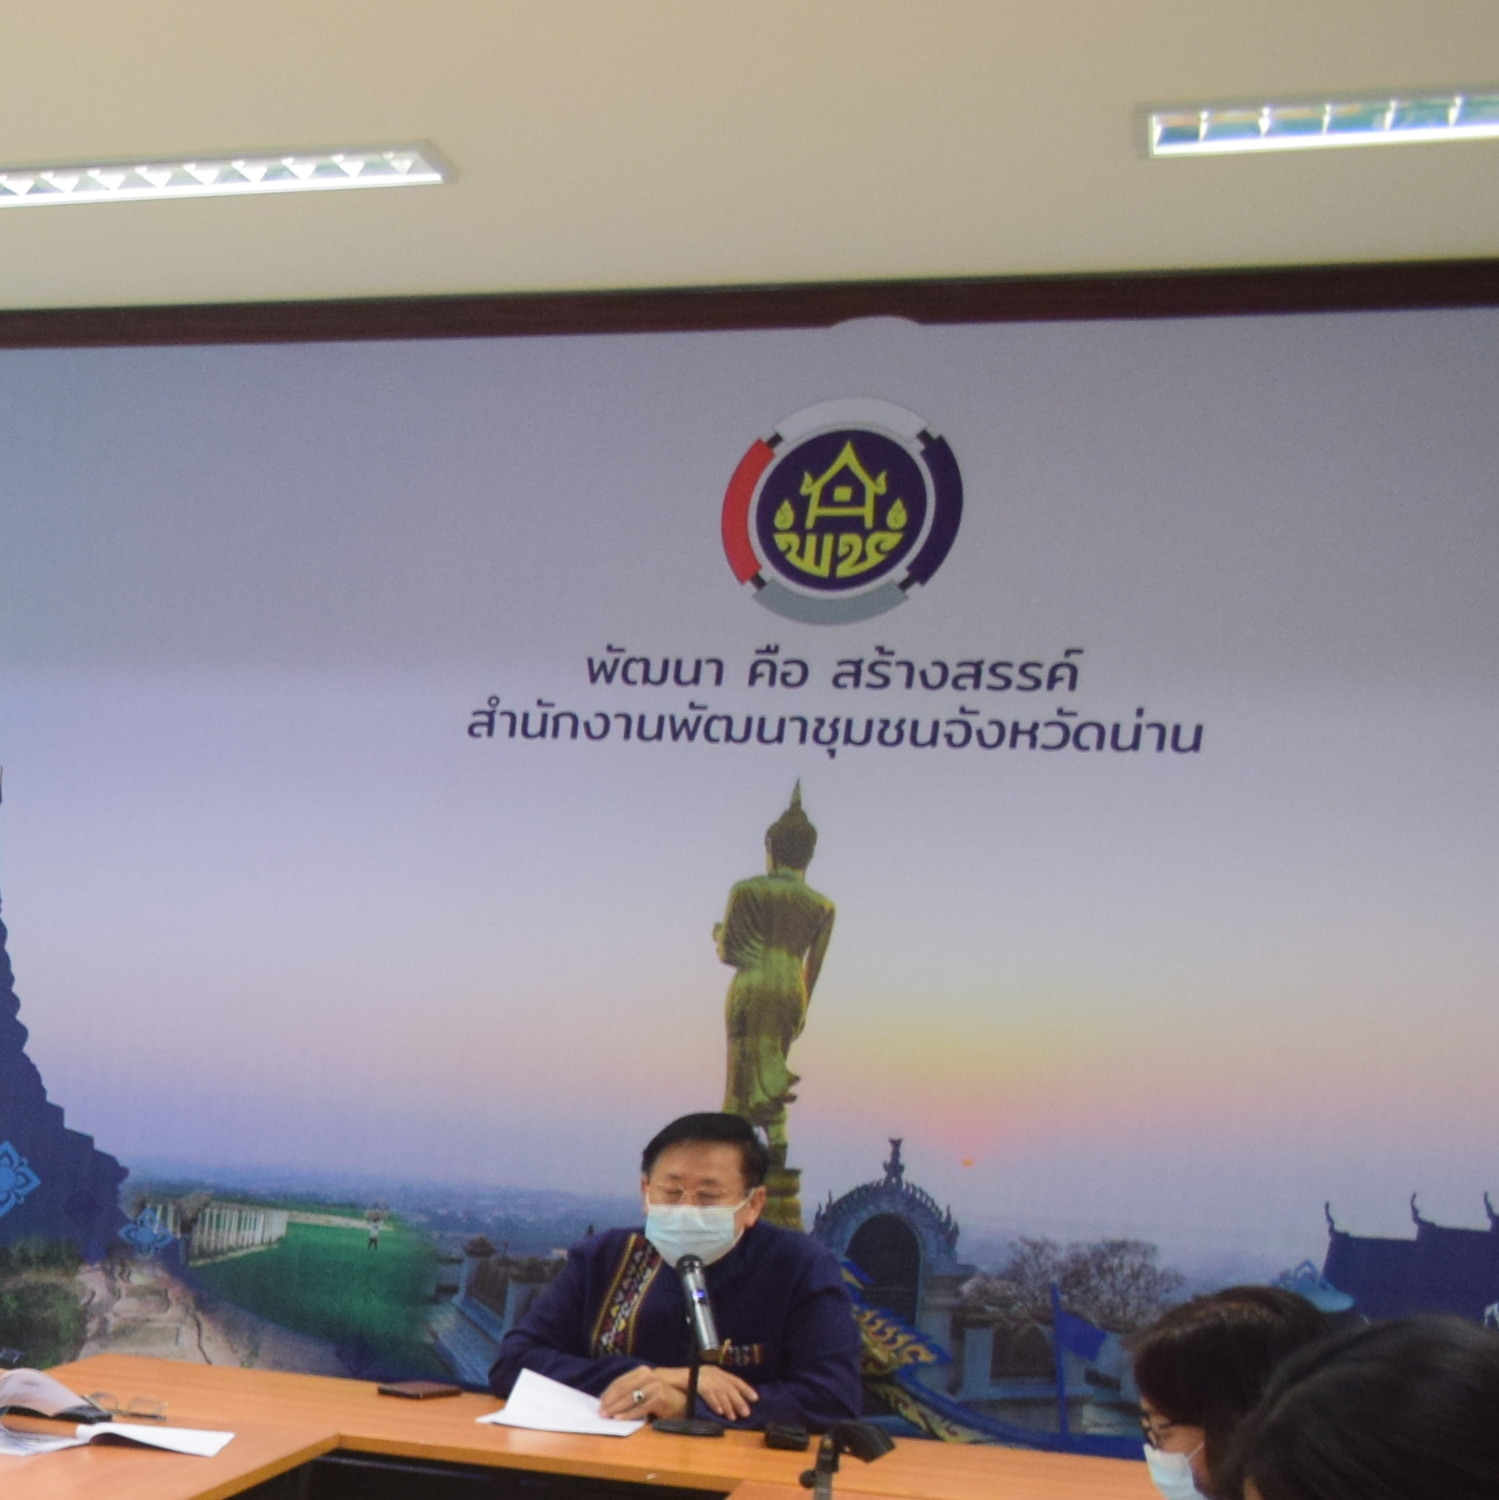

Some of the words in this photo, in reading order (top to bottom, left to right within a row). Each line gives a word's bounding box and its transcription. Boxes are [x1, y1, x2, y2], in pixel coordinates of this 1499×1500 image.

[586, 644, 725, 687] พัฒนา
[747, 643, 810, 689] คือ
[831, 645, 1085, 693] สร้างสรรค์
[467, 695, 1205, 760] สำนักงานพัฒนาชุมชนจังหวัดน่าน
